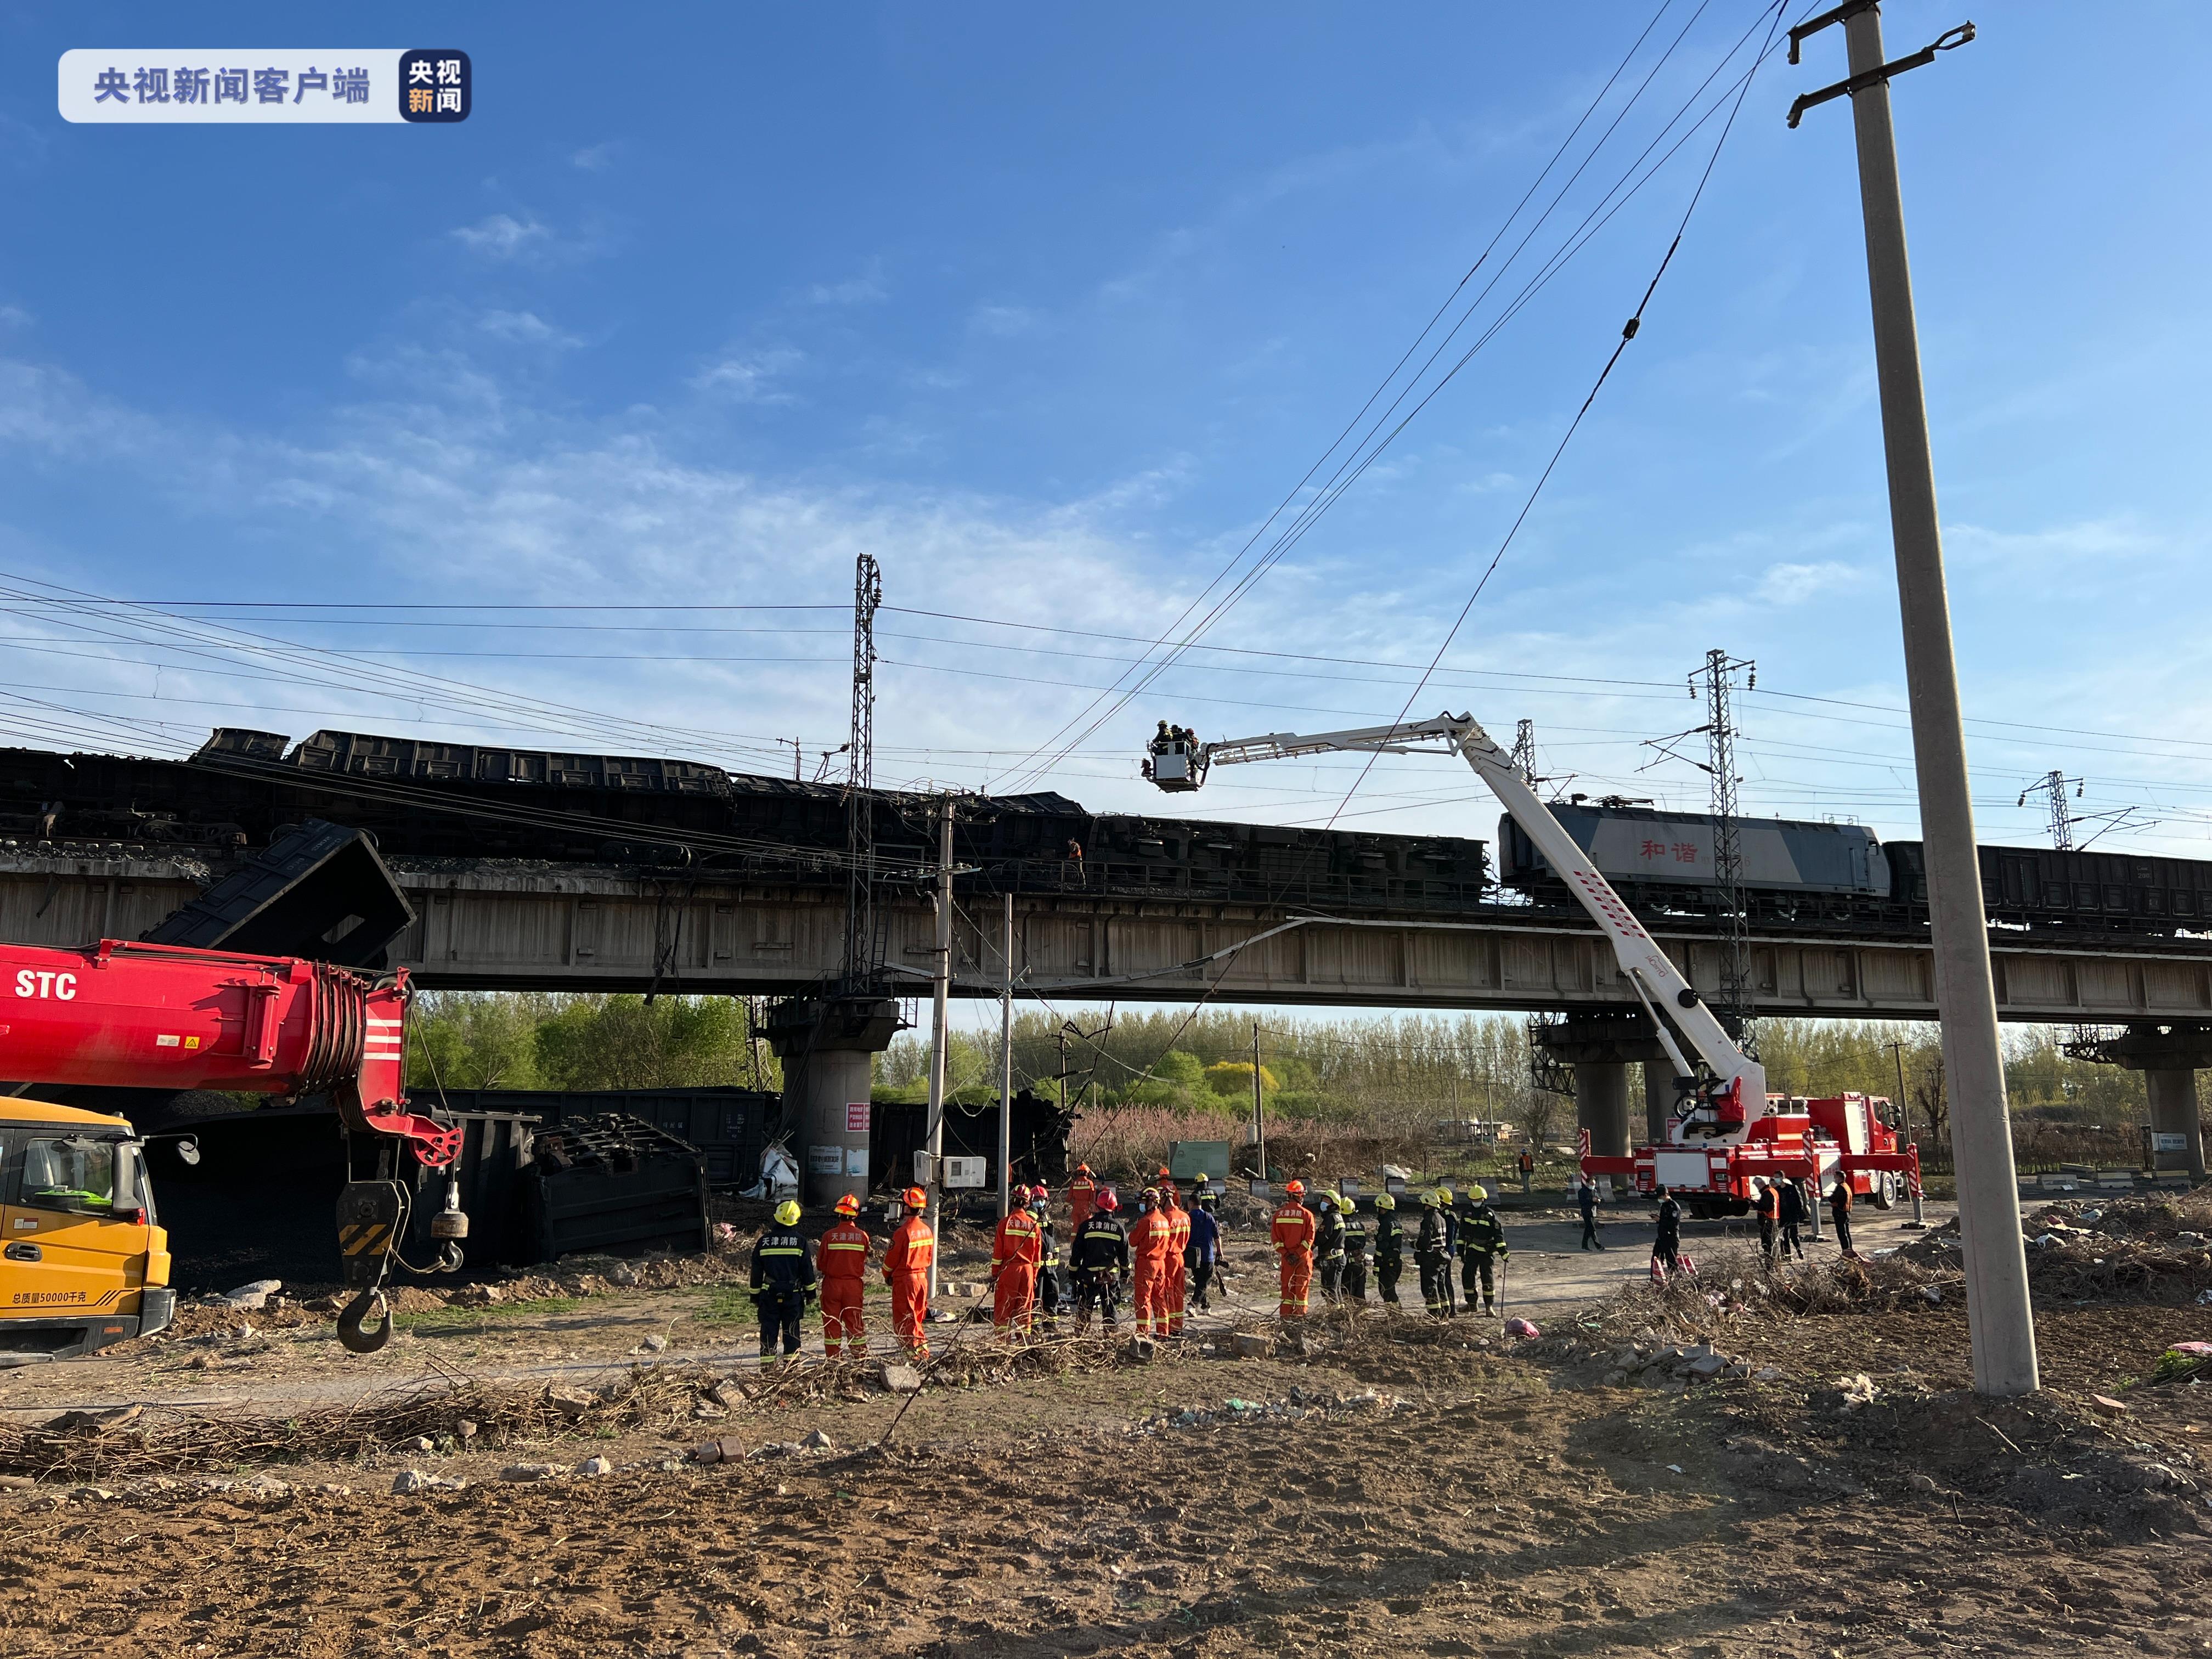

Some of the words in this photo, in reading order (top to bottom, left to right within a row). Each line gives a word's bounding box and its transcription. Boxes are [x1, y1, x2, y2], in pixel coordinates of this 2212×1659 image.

[1639, 839, 1698, 863] 和谐
[15, 969, 76, 1000] STC
[1088, 1221, 1118, 1232] 天津消防
[762, 1236, 798, 1246] 天津消防
[831, 1232, 862, 1242] 天津消防
[12, 1291, 87, 1304] 总质量50000千克
